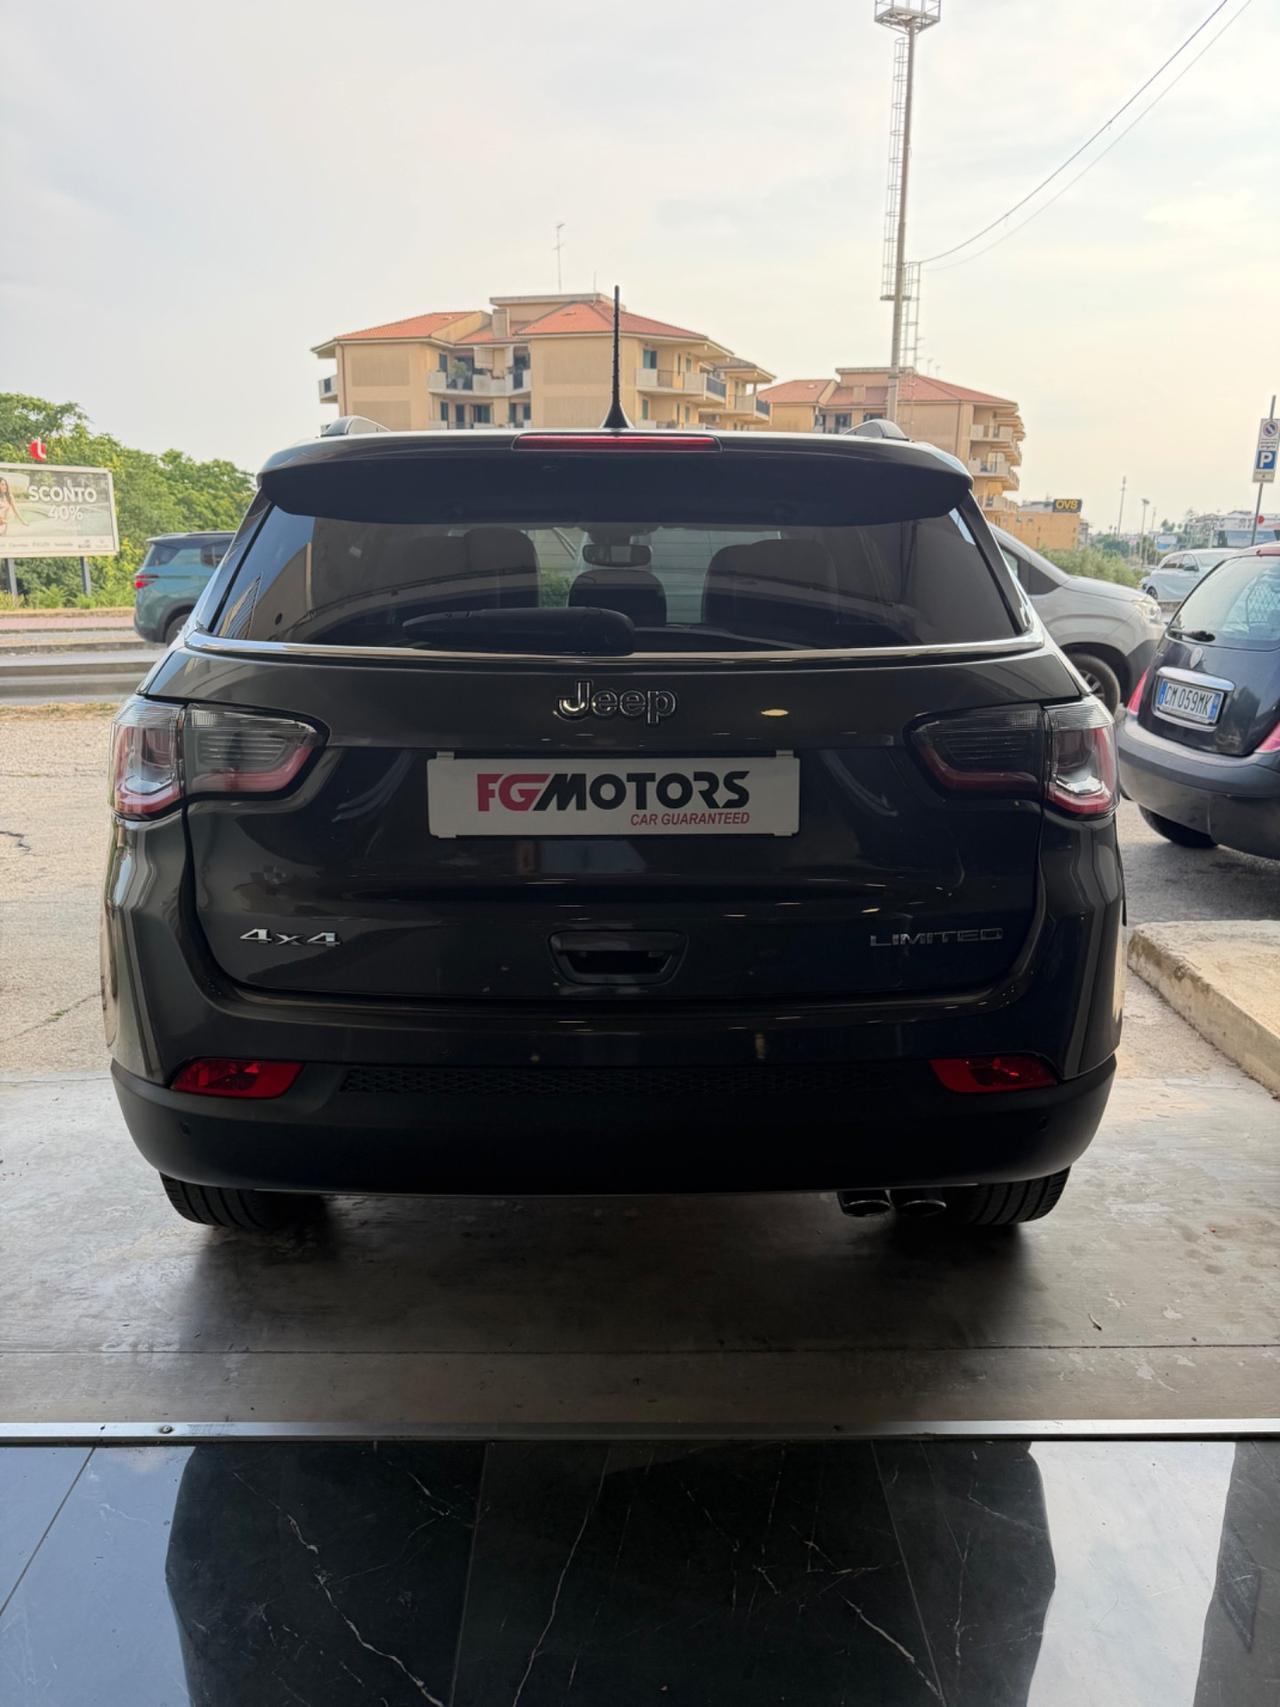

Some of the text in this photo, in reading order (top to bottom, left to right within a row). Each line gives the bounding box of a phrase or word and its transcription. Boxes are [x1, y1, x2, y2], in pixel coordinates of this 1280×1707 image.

[1259, 451, 1274, 468] P
[28, 485, 97, 503] SCONTO
[47, 504, 84, 521] 40%
[1055, 499, 1079, 510] OVS
[555, 680, 677, 724] Jeep
[1177, 688, 1213, 715] 059MK
[630, 811, 751, 827] CAR GUARANTEED
[239, 928, 341, 947] 4x4
[870, 928, 1004, 947] LIMITED
